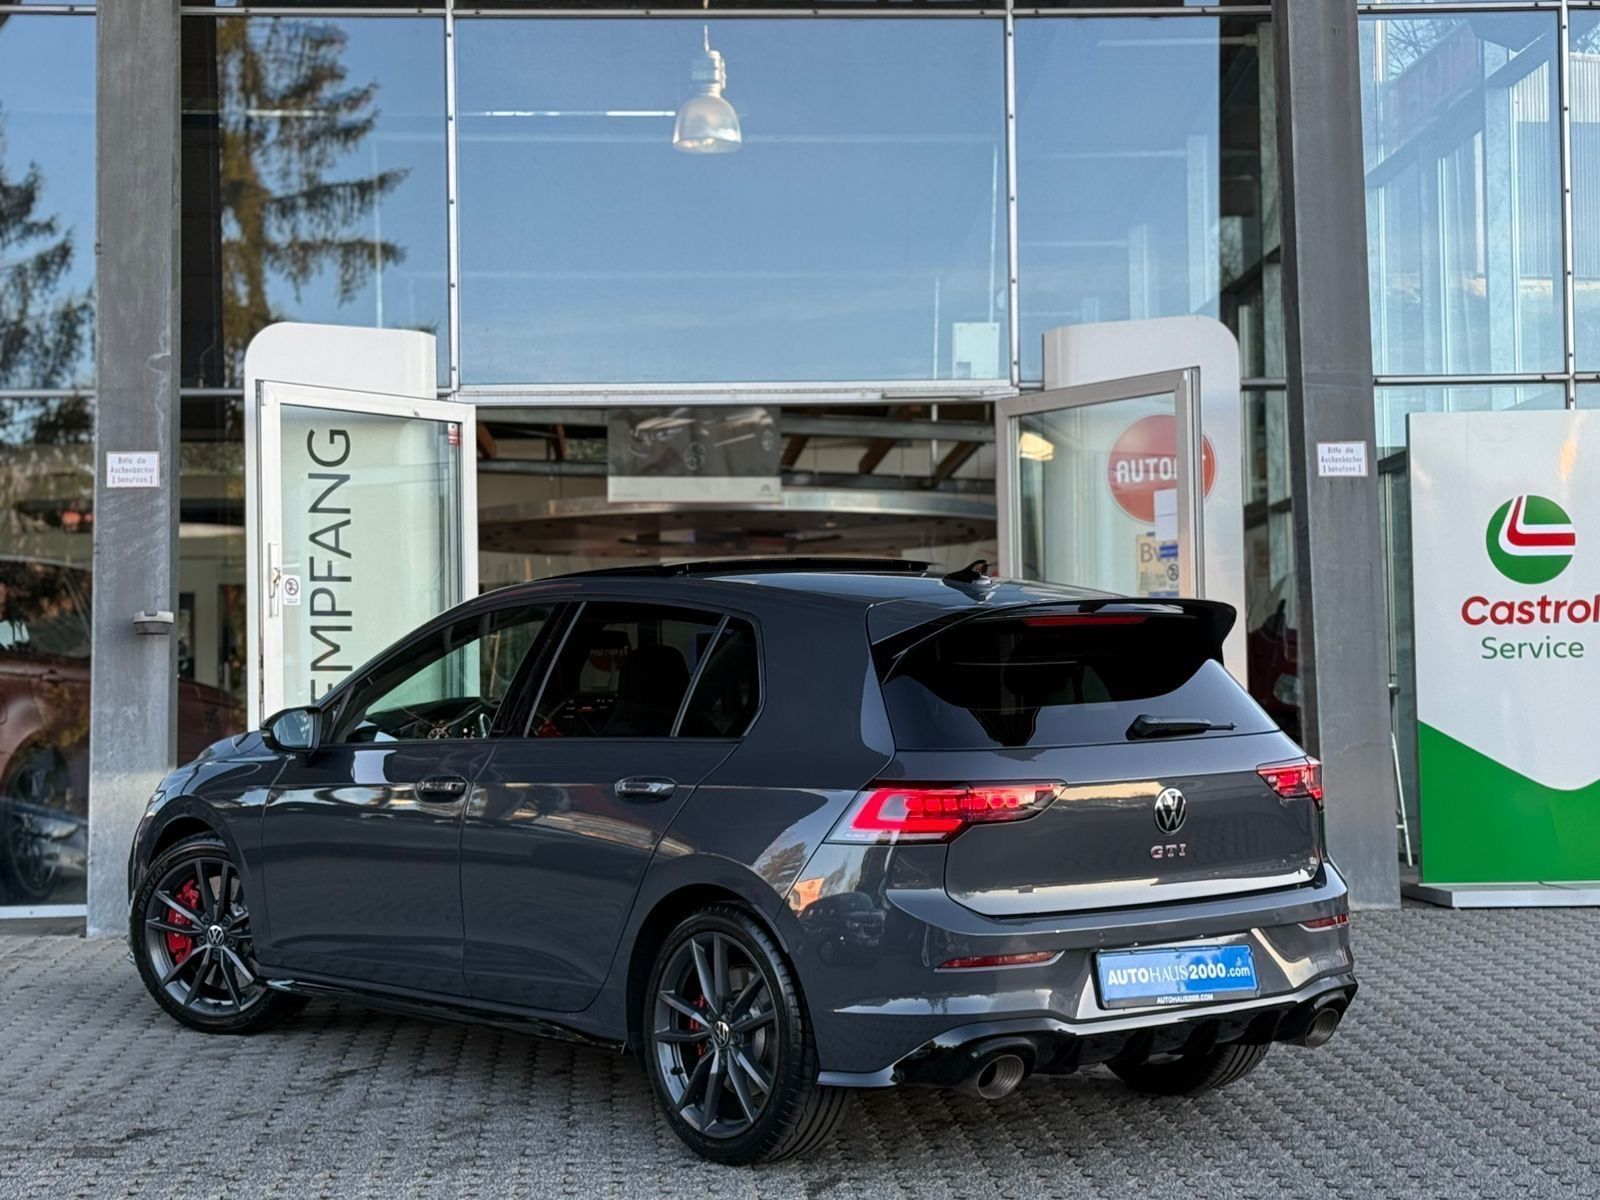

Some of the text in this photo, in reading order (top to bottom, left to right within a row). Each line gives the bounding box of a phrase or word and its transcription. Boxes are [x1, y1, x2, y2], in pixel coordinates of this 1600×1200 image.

[1116, 455, 1206, 484] AUTO
[1461, 594, 1600, 625] Castrol
[1481, 635, 1584, 659] Service
[1150, 843, 1187, 859] GTI
[1108, 962, 1250, 986] AUTOHAUS2000.com
